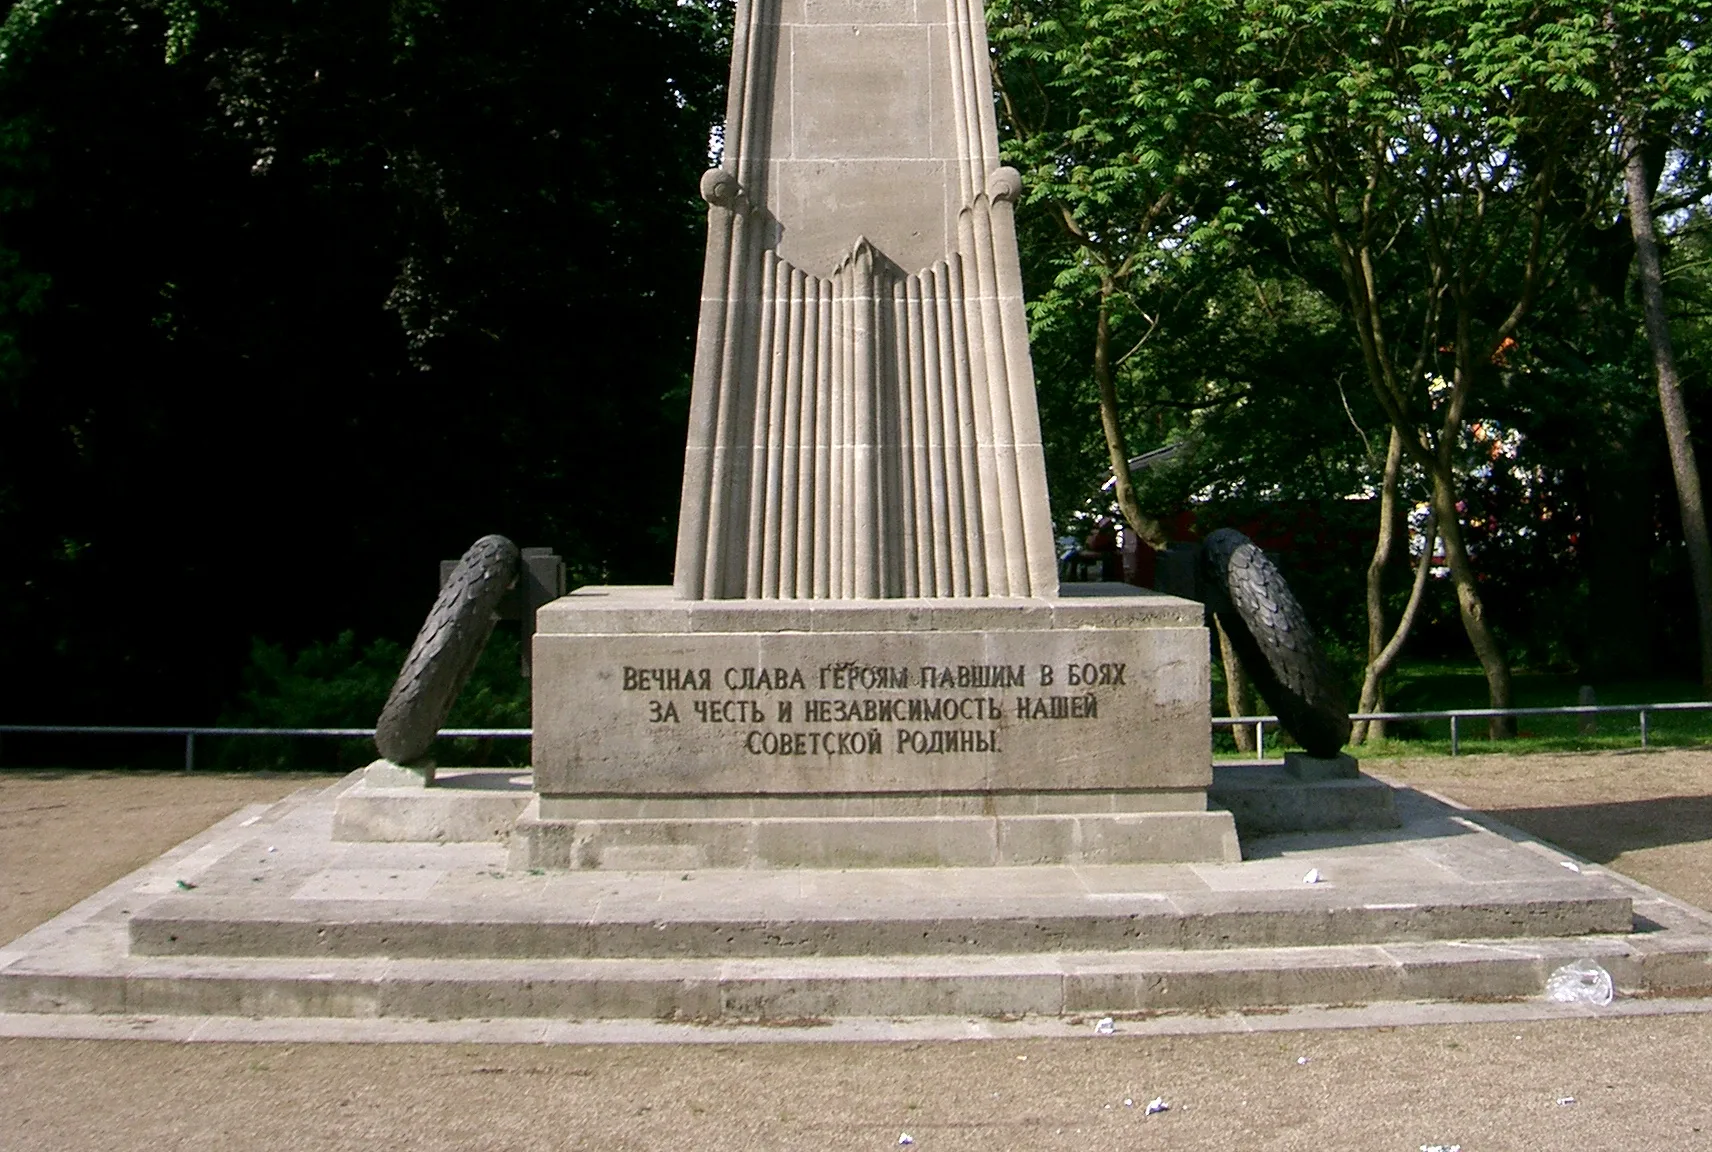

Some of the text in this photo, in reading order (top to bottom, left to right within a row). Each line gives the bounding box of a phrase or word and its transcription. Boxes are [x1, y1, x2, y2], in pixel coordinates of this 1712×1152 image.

[622, 666, 711, 691] ВЕЧНАЯ
[724, 667, 805, 691] СЛАВА
[920, 665, 1024, 689] ПАВШИМ
[1039, 665, 1054, 687] В
[1067, 663, 1126, 686] БОЯХ
[648, 693, 1098, 723] ЗА ЧЕСТЬ И НЕЗАВИСИМОСТЬ НАШЕЙ
[745, 729, 882, 755] СОВЕТСКОЙ
